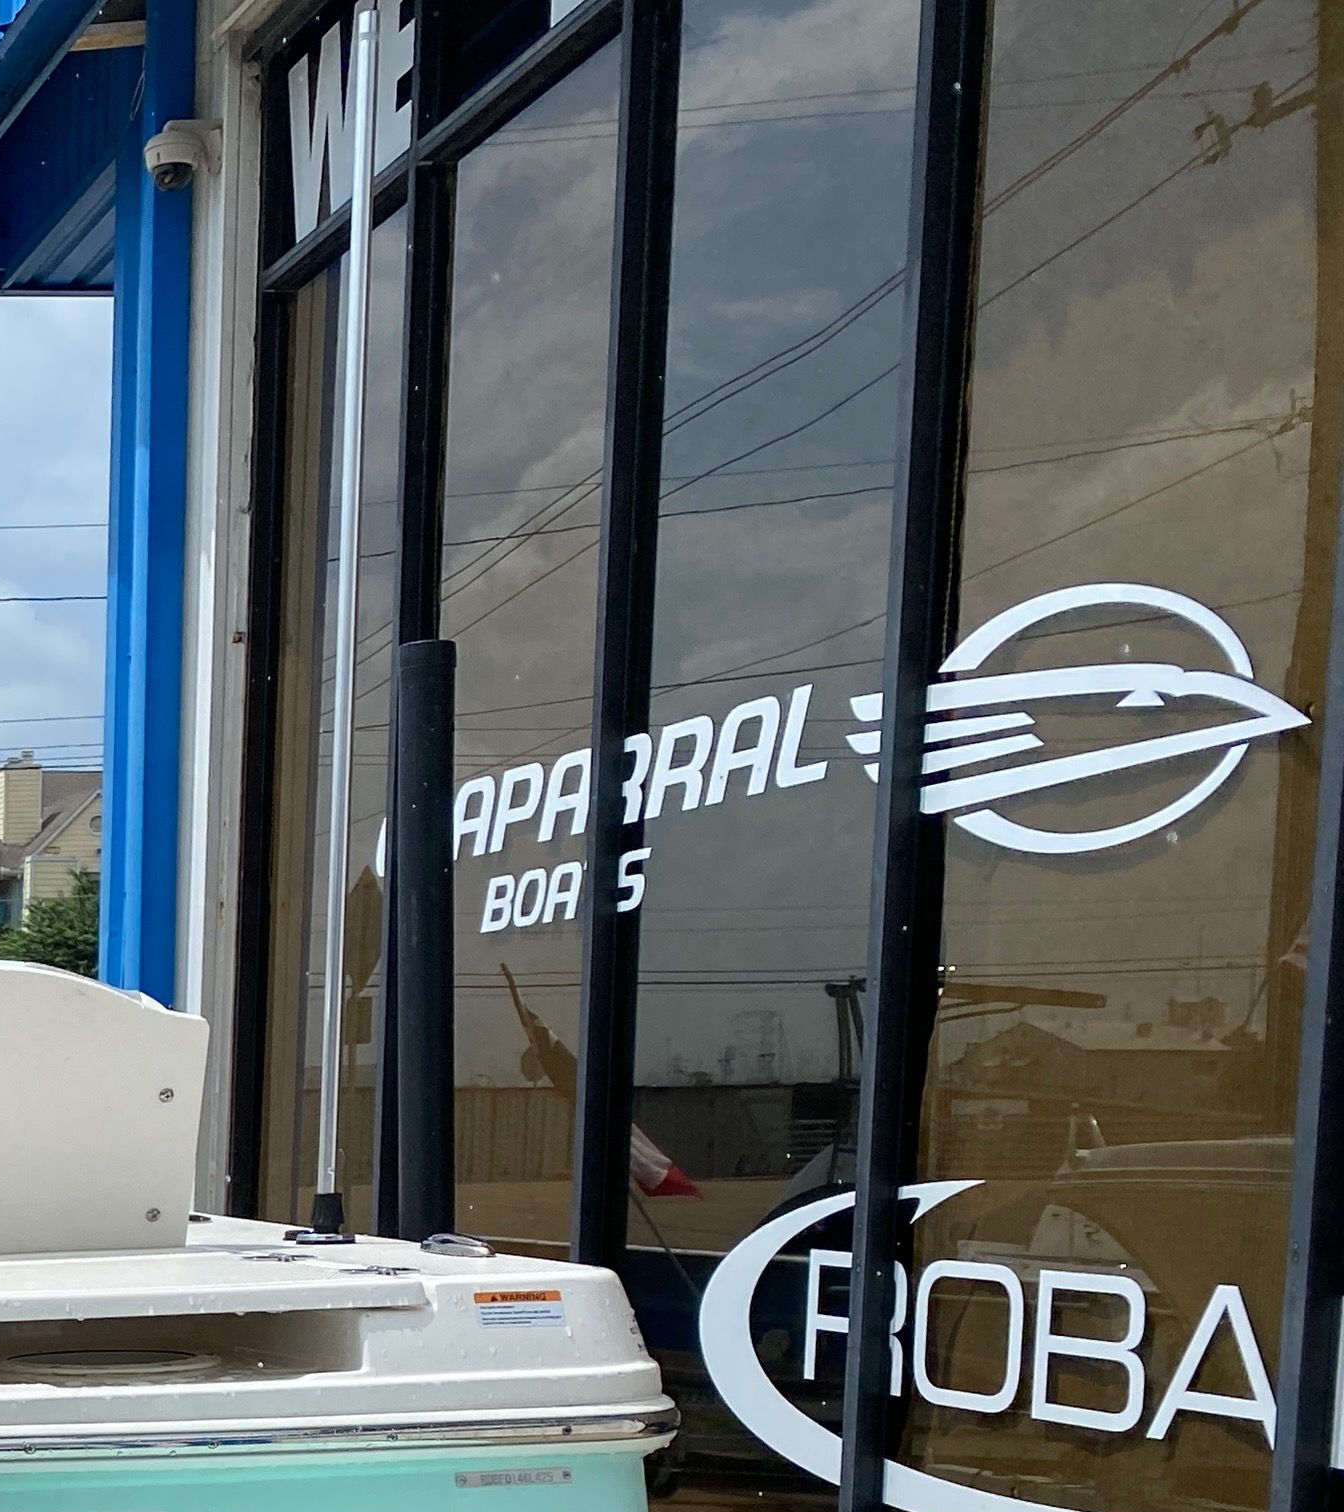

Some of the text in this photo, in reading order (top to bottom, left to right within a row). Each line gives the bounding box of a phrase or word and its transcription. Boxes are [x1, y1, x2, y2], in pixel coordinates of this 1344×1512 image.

[480, 847, 652, 934] BOAS
[499, 1292, 547, 1302] WARNING
[803, 1249, 1344, 1469] ROBA
